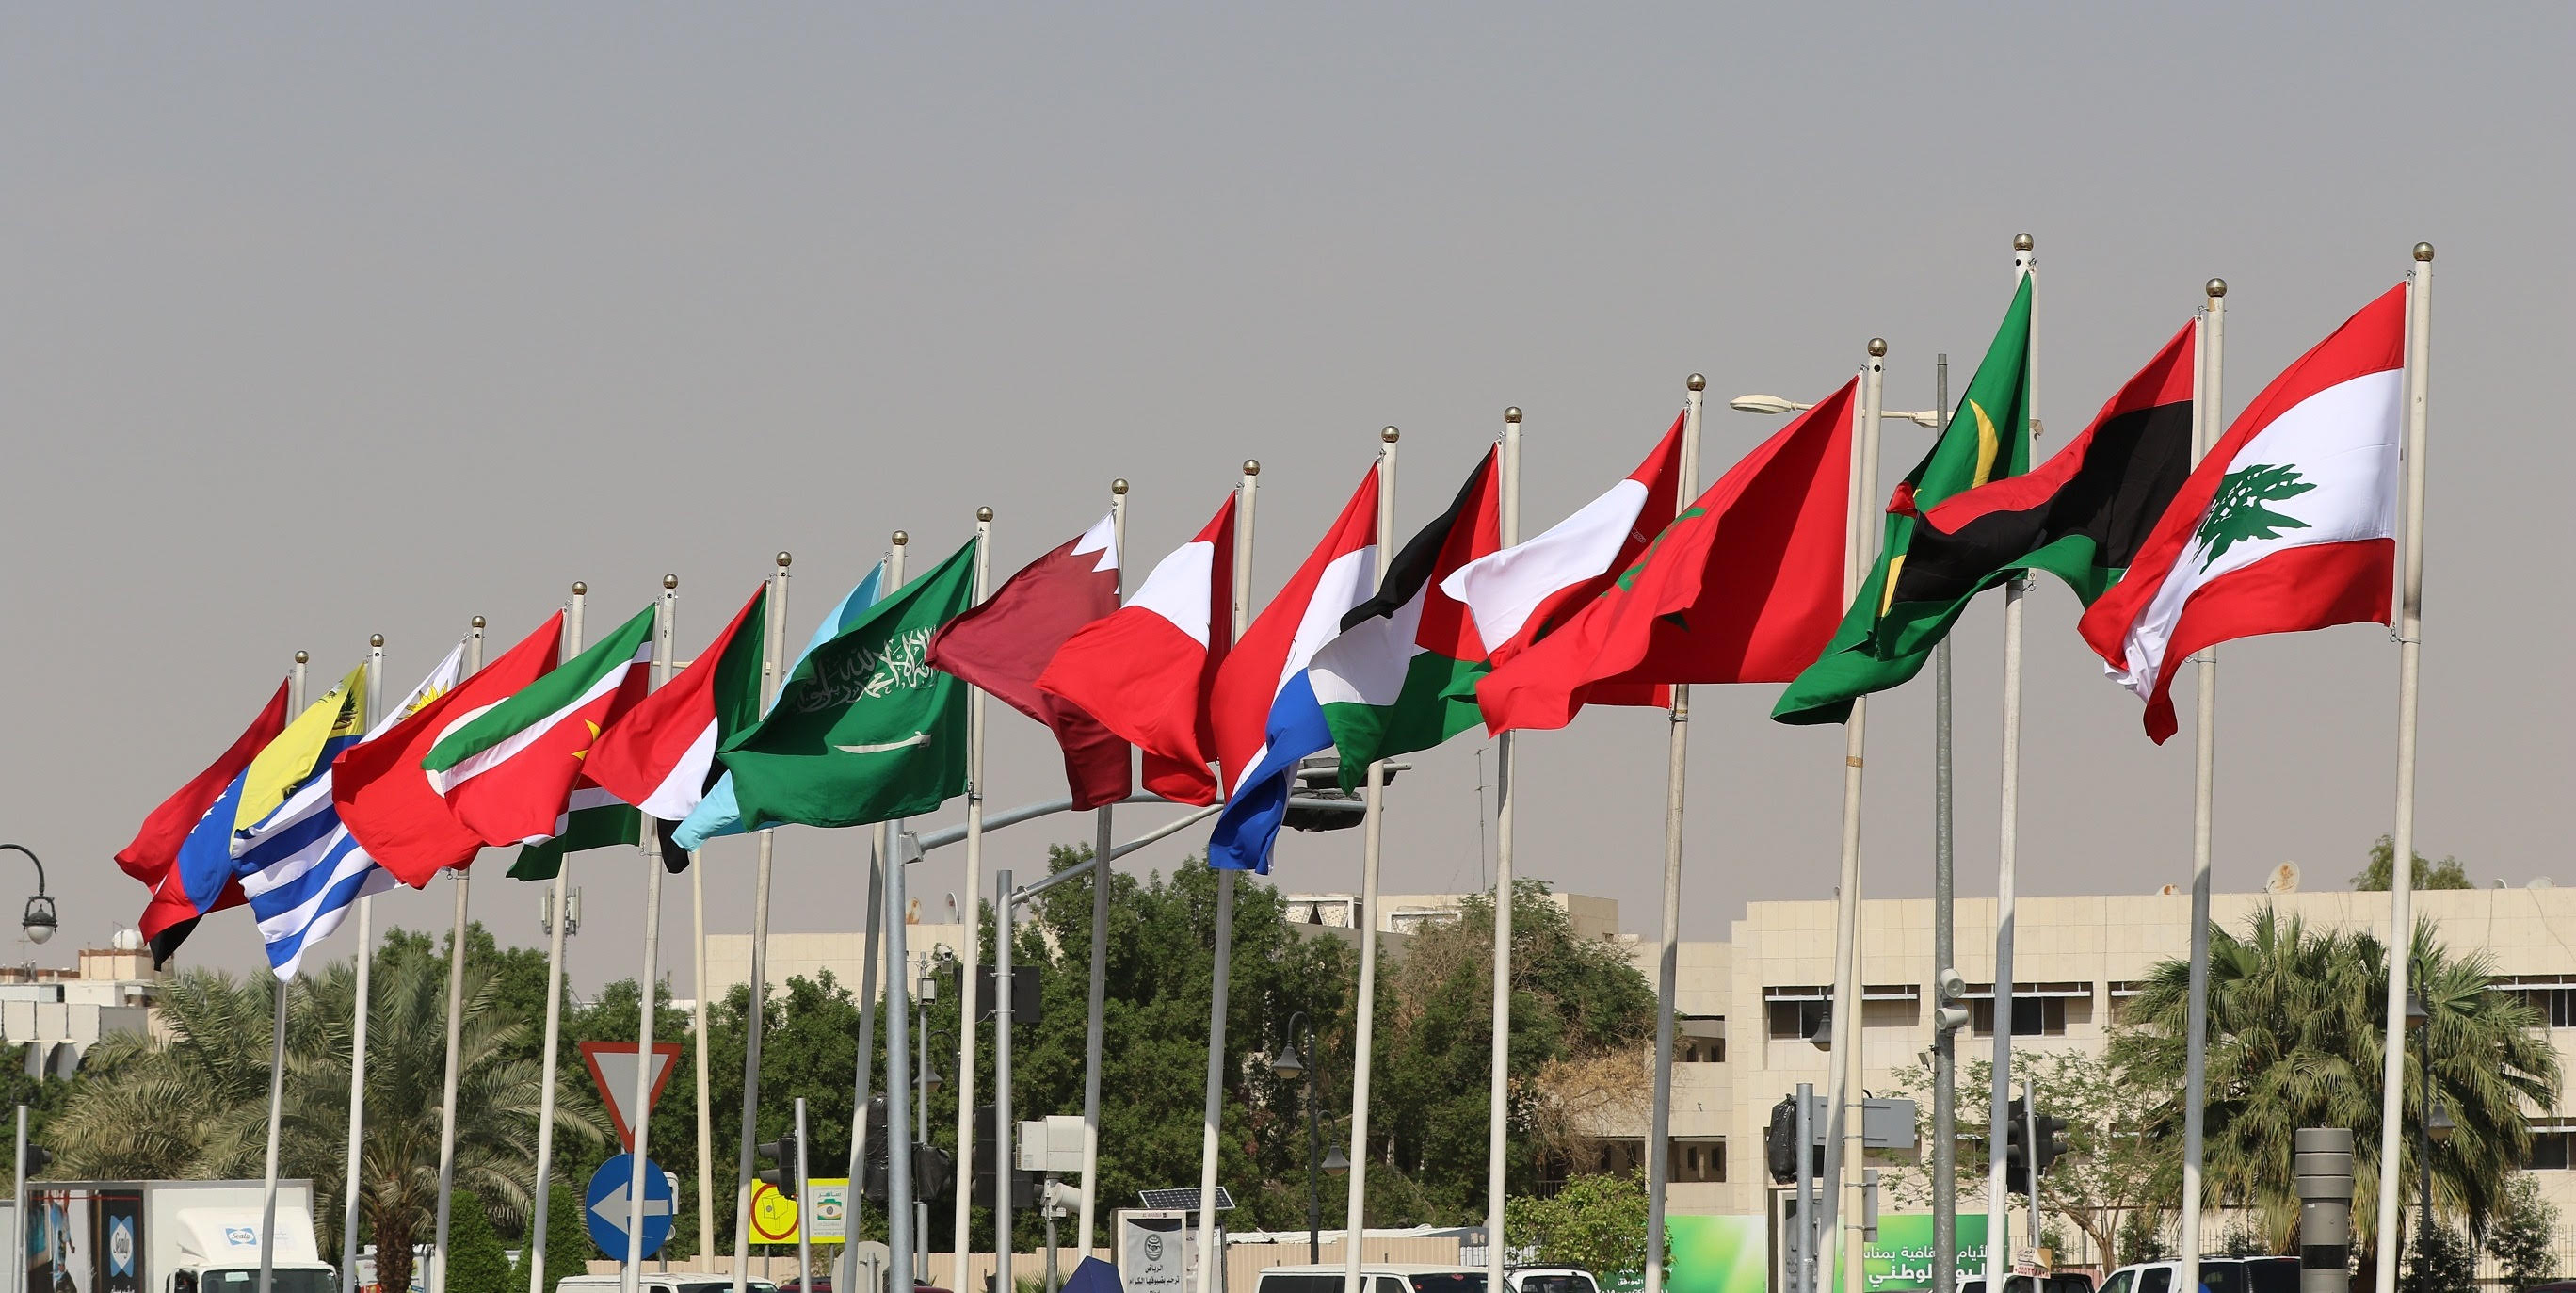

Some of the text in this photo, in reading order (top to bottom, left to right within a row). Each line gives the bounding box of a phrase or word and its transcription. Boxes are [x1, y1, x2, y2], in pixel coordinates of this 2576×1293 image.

[114, 1232, 130, 1259] Sealy
[1145, 1264, 1164, 1273] الرياض
[1869, 1264, 1932, 1287] لوطني
[1129, 1275, 1180, 1285] ترحب بضيوفها الكرام
